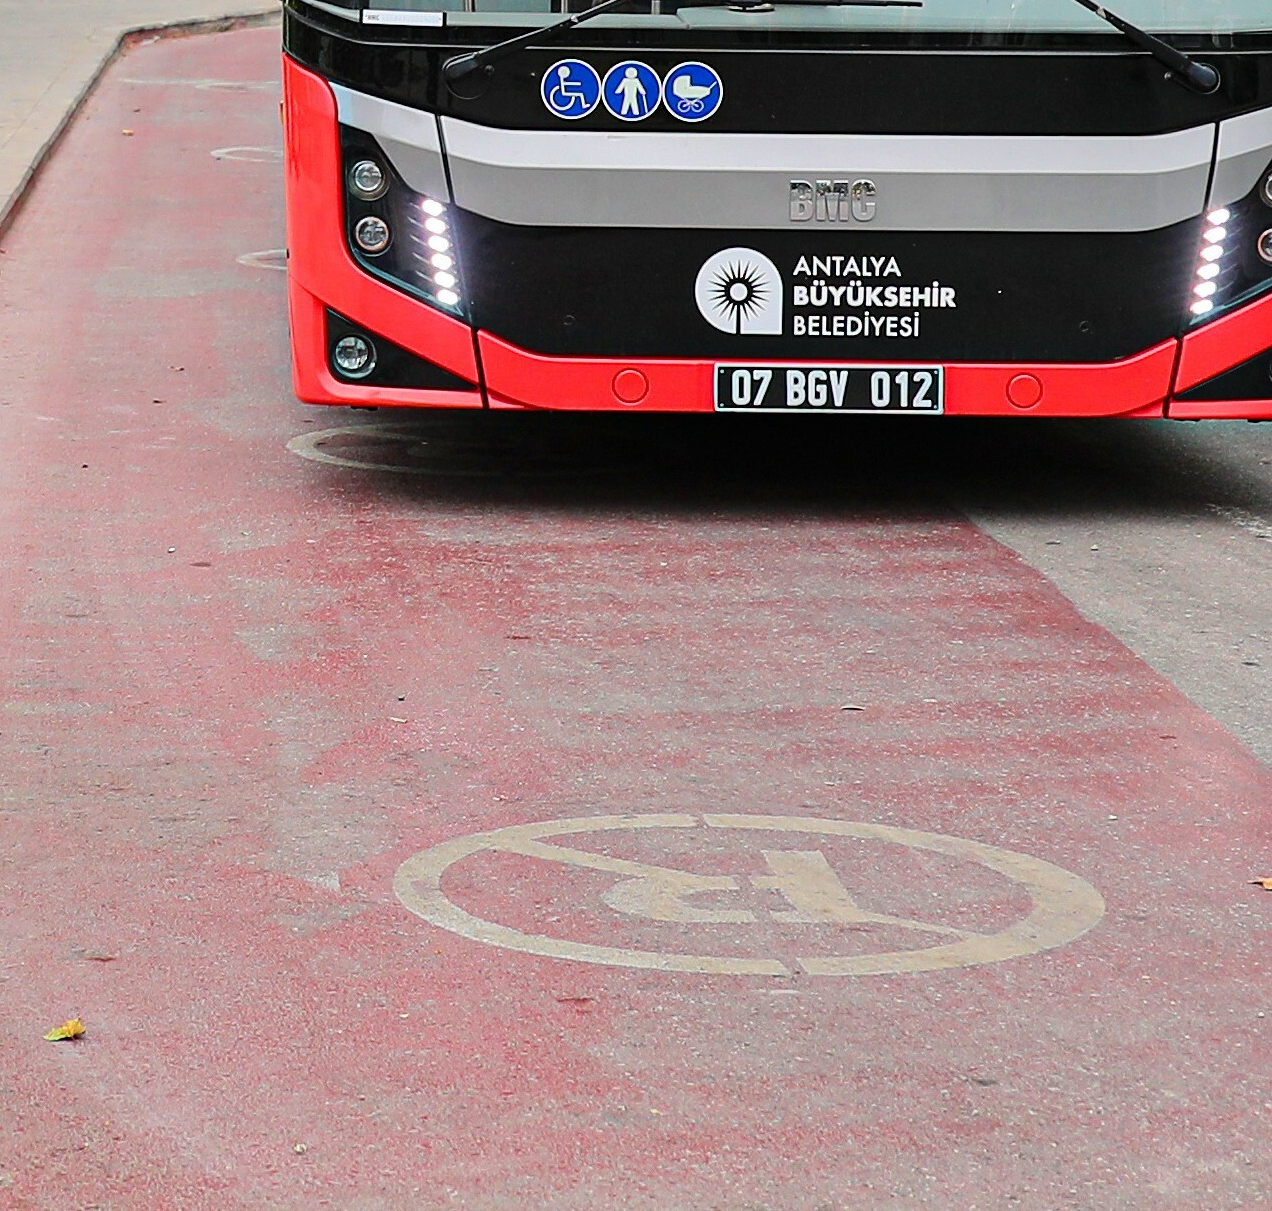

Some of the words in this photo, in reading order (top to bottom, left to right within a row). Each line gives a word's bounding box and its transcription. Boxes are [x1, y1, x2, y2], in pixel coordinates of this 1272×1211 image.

[790, 179, 877, 221] BMC
[793, 255, 902, 277] ANTALYA
[793, 311, 920, 337] BELEDİYESİ
[731, 369, 773, 406] 07
[786, 370, 849, 407] BGV
[870, 371, 933, 408] 012
